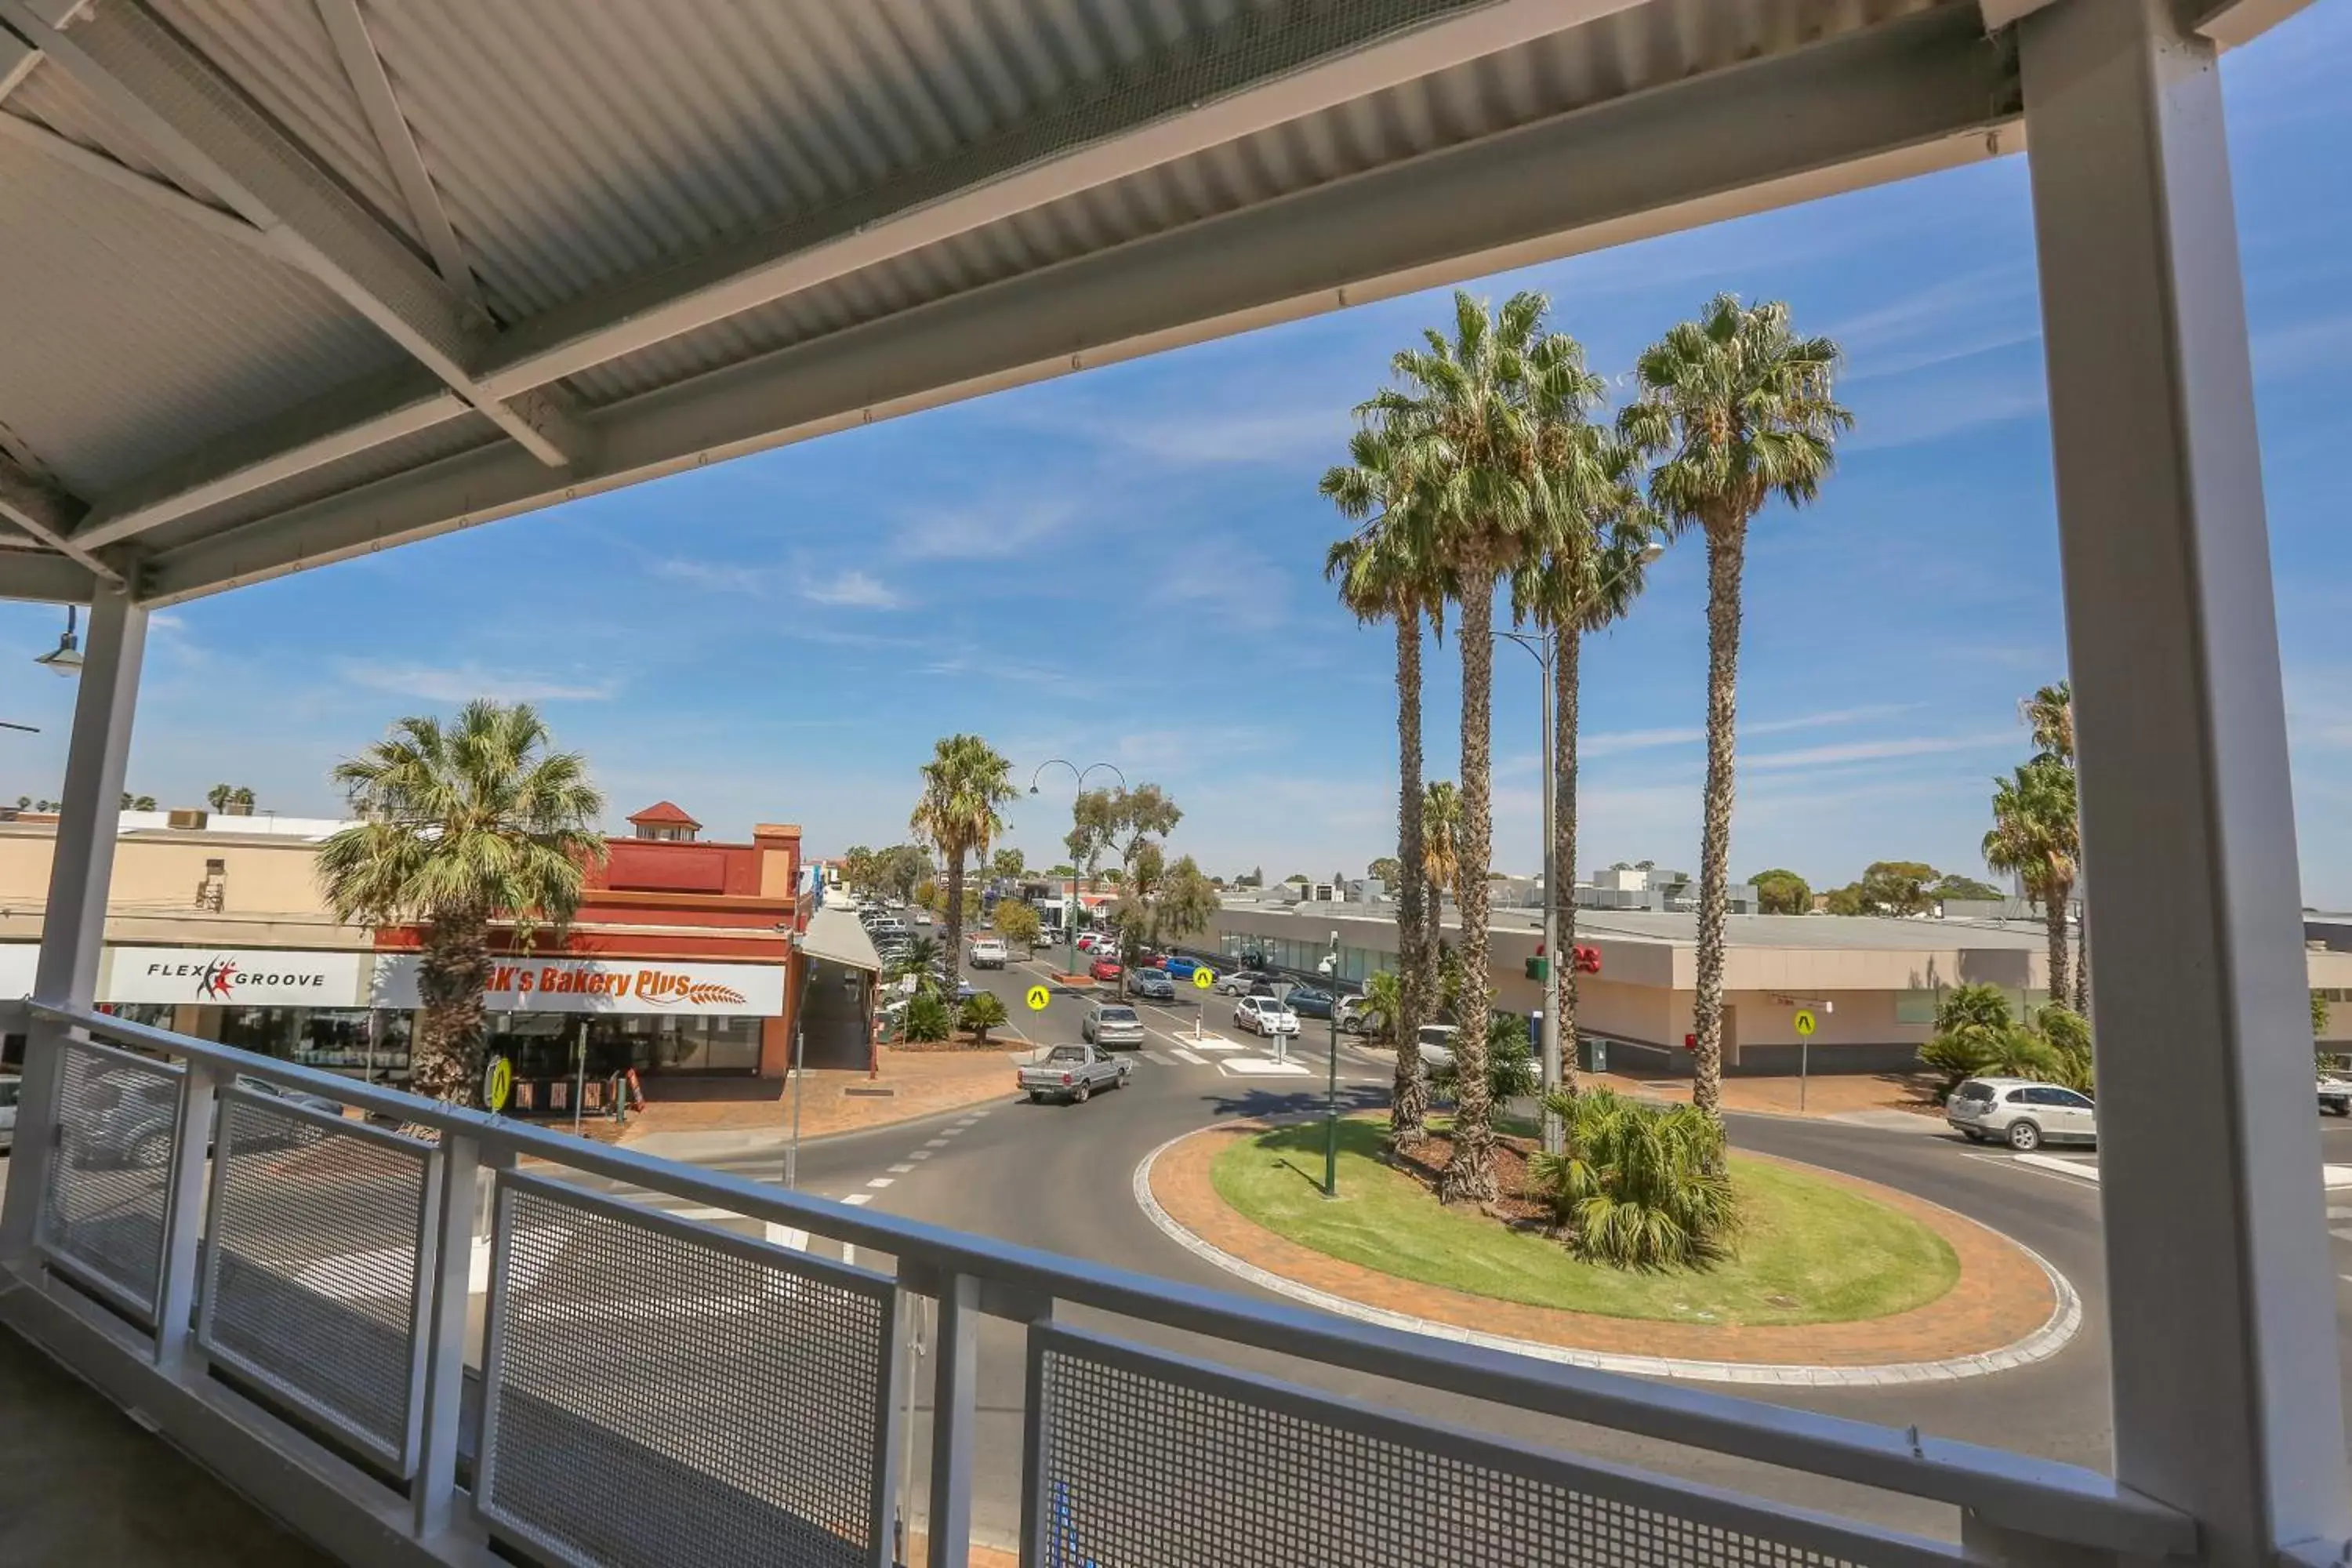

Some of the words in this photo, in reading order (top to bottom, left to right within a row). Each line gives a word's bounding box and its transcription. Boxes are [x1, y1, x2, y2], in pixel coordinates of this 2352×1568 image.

[147, 964, 206, 977] FLEX
[234, 972, 325, 986] GROOVE
[539, 966, 632, 998] Bakery
[634, 969, 691, 998] Plus
